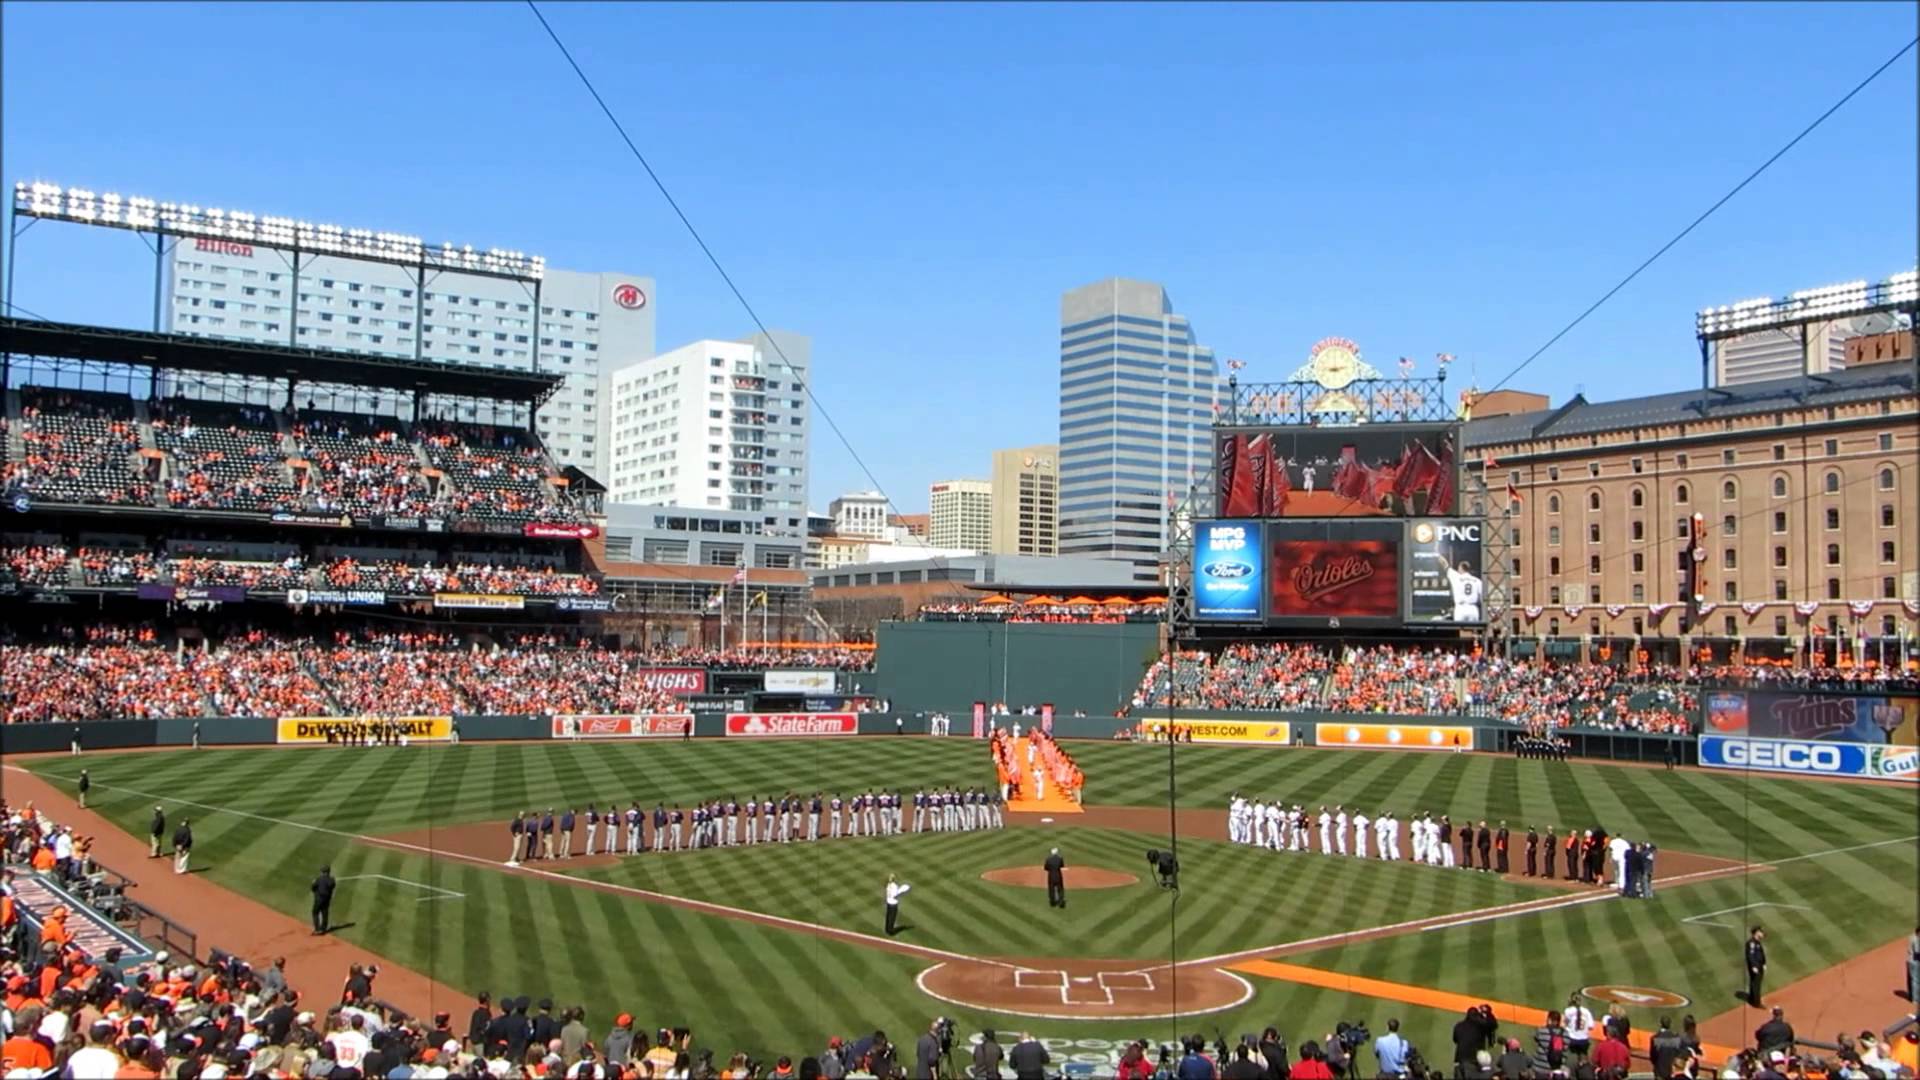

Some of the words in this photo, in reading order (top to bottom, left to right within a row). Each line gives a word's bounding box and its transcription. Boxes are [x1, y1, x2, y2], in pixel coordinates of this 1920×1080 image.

[195, 237, 254, 257] Hilton
[1210, 528, 1246, 540] MPG
[1437, 525, 1480, 541] PNC
[1211, 562, 1244, 576] Ford
[1295, 556, 1374, 600] Orioles
[347, 591, 385, 602] UNION
[1464, 583, 1473, 595] 8
[1772, 696, 1856, 738] Twins
[1722, 740, 1841, 770] GEICO
[1883, 755, 1918, 773] Gul
